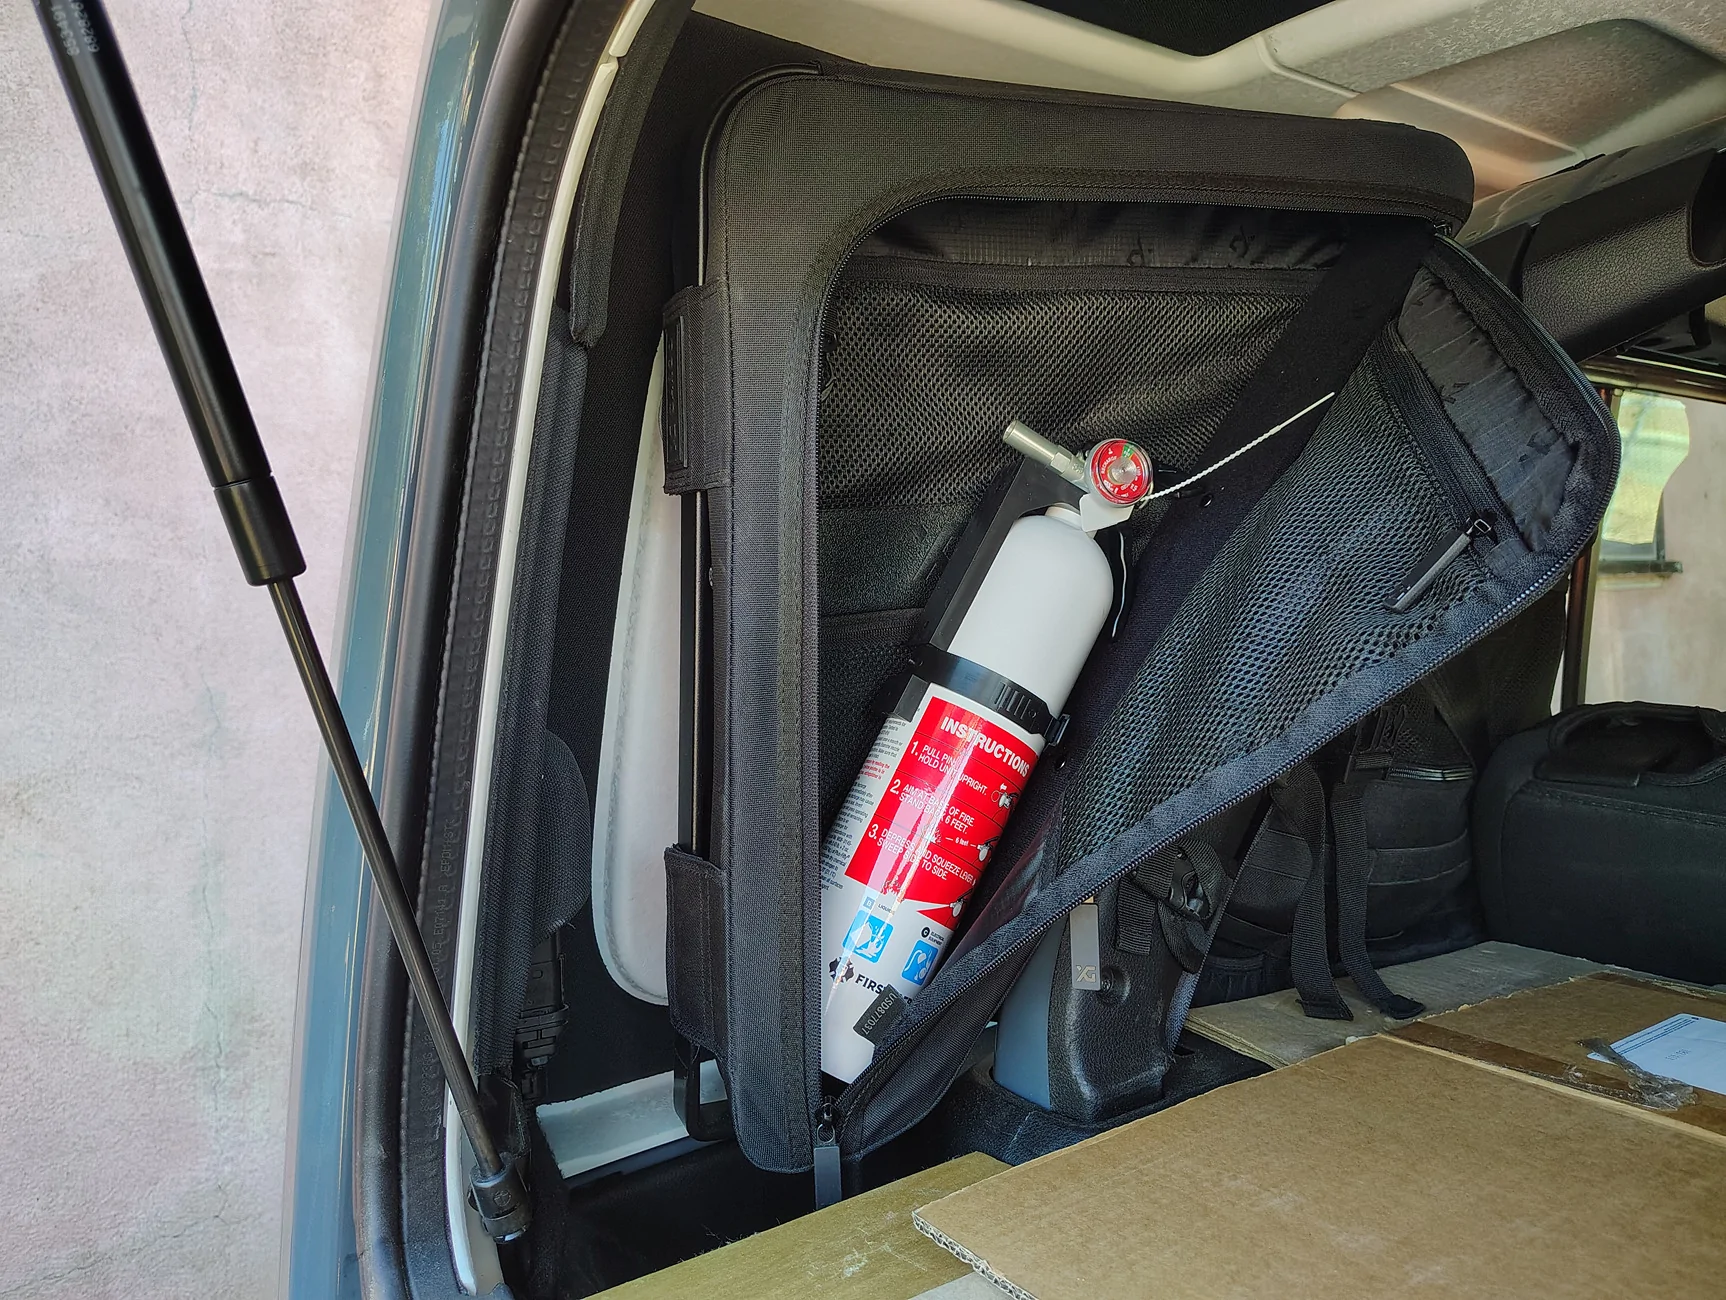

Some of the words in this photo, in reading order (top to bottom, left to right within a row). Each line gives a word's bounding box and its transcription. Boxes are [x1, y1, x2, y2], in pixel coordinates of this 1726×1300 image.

[911, 741, 919, 756] 1.
[922, 745, 940, 760] PULL
[940, 716, 1030, 778] INSTRUCTIONS
[918, 753, 940, 768] HOLD
[940, 763, 958, 777] UNIT
[890, 779, 900, 794] 2.
[949, 806, 960, 818] OF
[959, 812, 974, 826] FIRE
[899, 792, 924, 810] STAND
[945, 815, 950, 824] 6
[868, 824, 878, 839] 3.
[881, 828, 916, 852] DEPRESS
[932, 854, 961, 876] SQUEEZE
[877, 838, 904, 855] SWEEP
[922, 859, 932, 871] TO
[855, 974, 886, 994] FIRS
[862, 993, 898, 1035] USD877037
